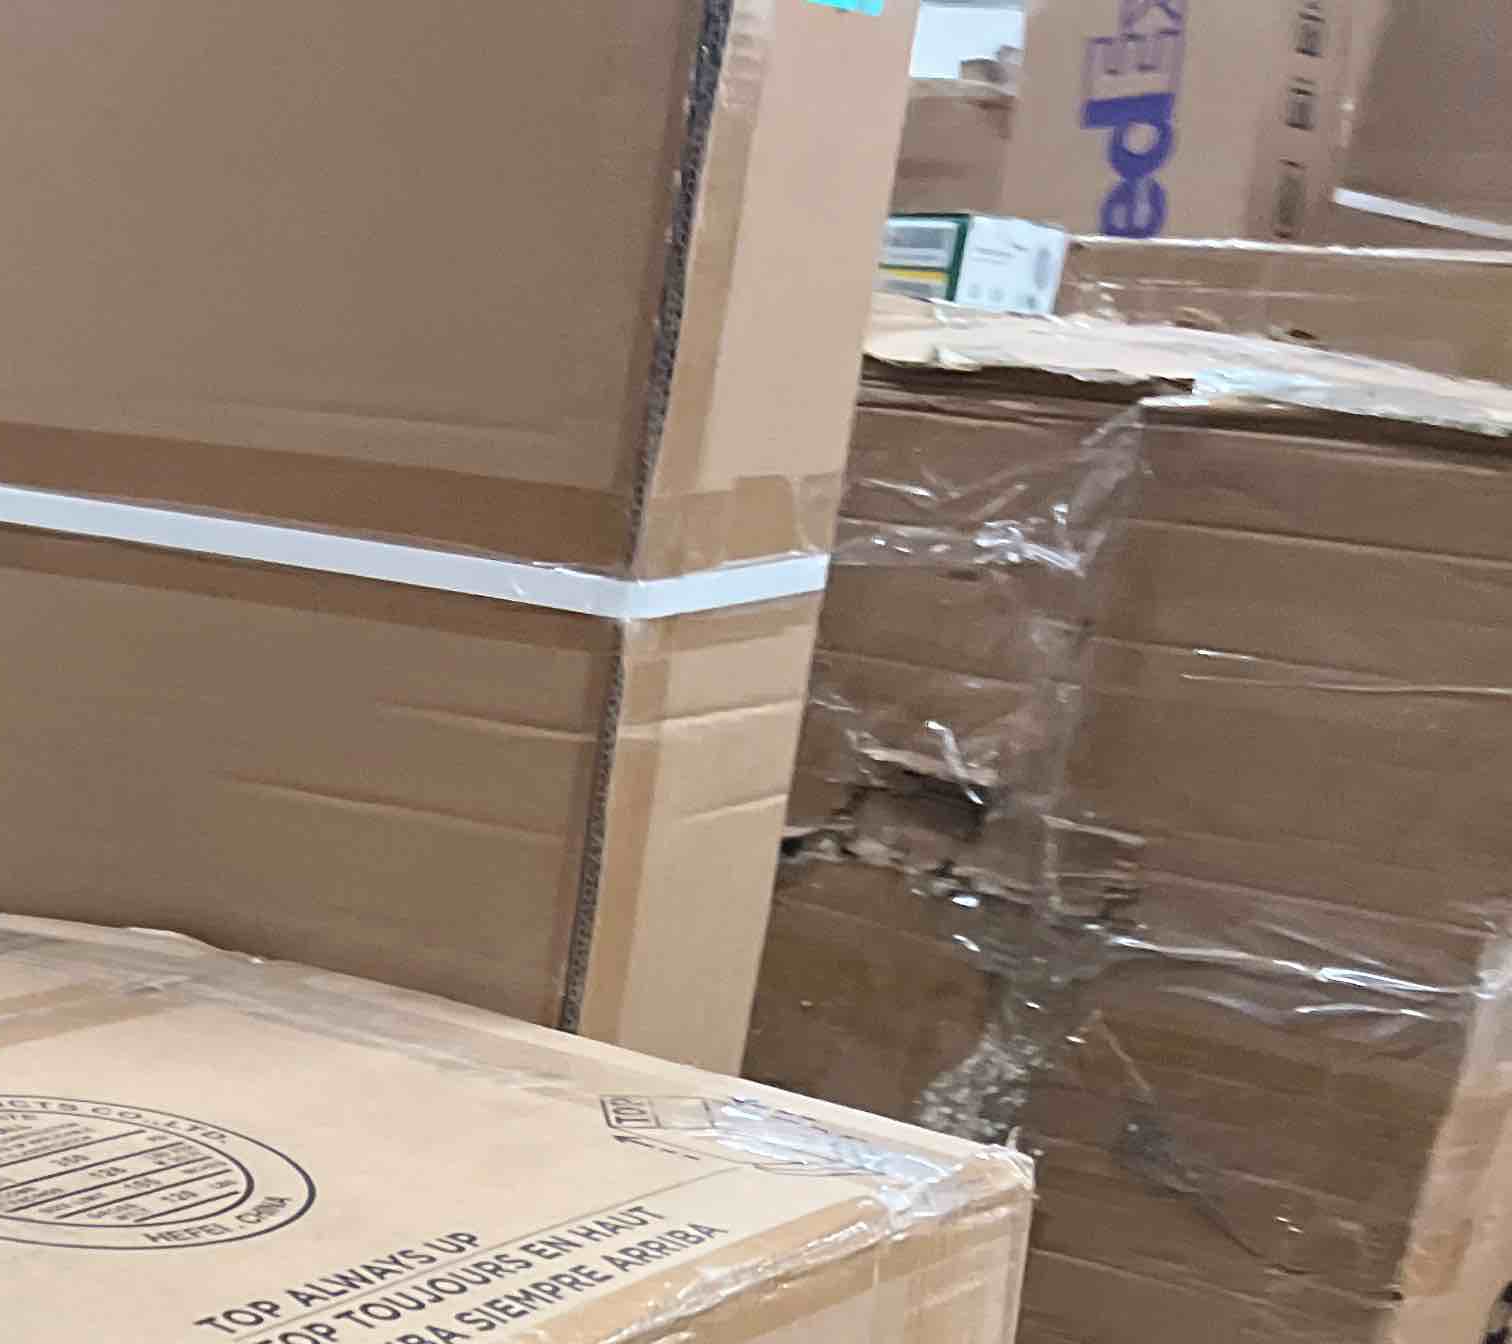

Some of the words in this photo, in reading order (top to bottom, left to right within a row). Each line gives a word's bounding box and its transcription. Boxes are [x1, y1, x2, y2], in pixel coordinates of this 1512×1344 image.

[193, 1300, 284, 1337] TOP
[285, 1247, 432, 1308] ALWAYS
[436, 1231, 482, 1256] UP
[333, 1253, 534, 1330] TOUJOURS
[523, 1234, 583, 1262] EN
[569, 1205, 668, 1247] HAUT
[456, 1265, 614, 1332] SIEMPRE
[602, 1222, 729, 1272] ARRIBA
